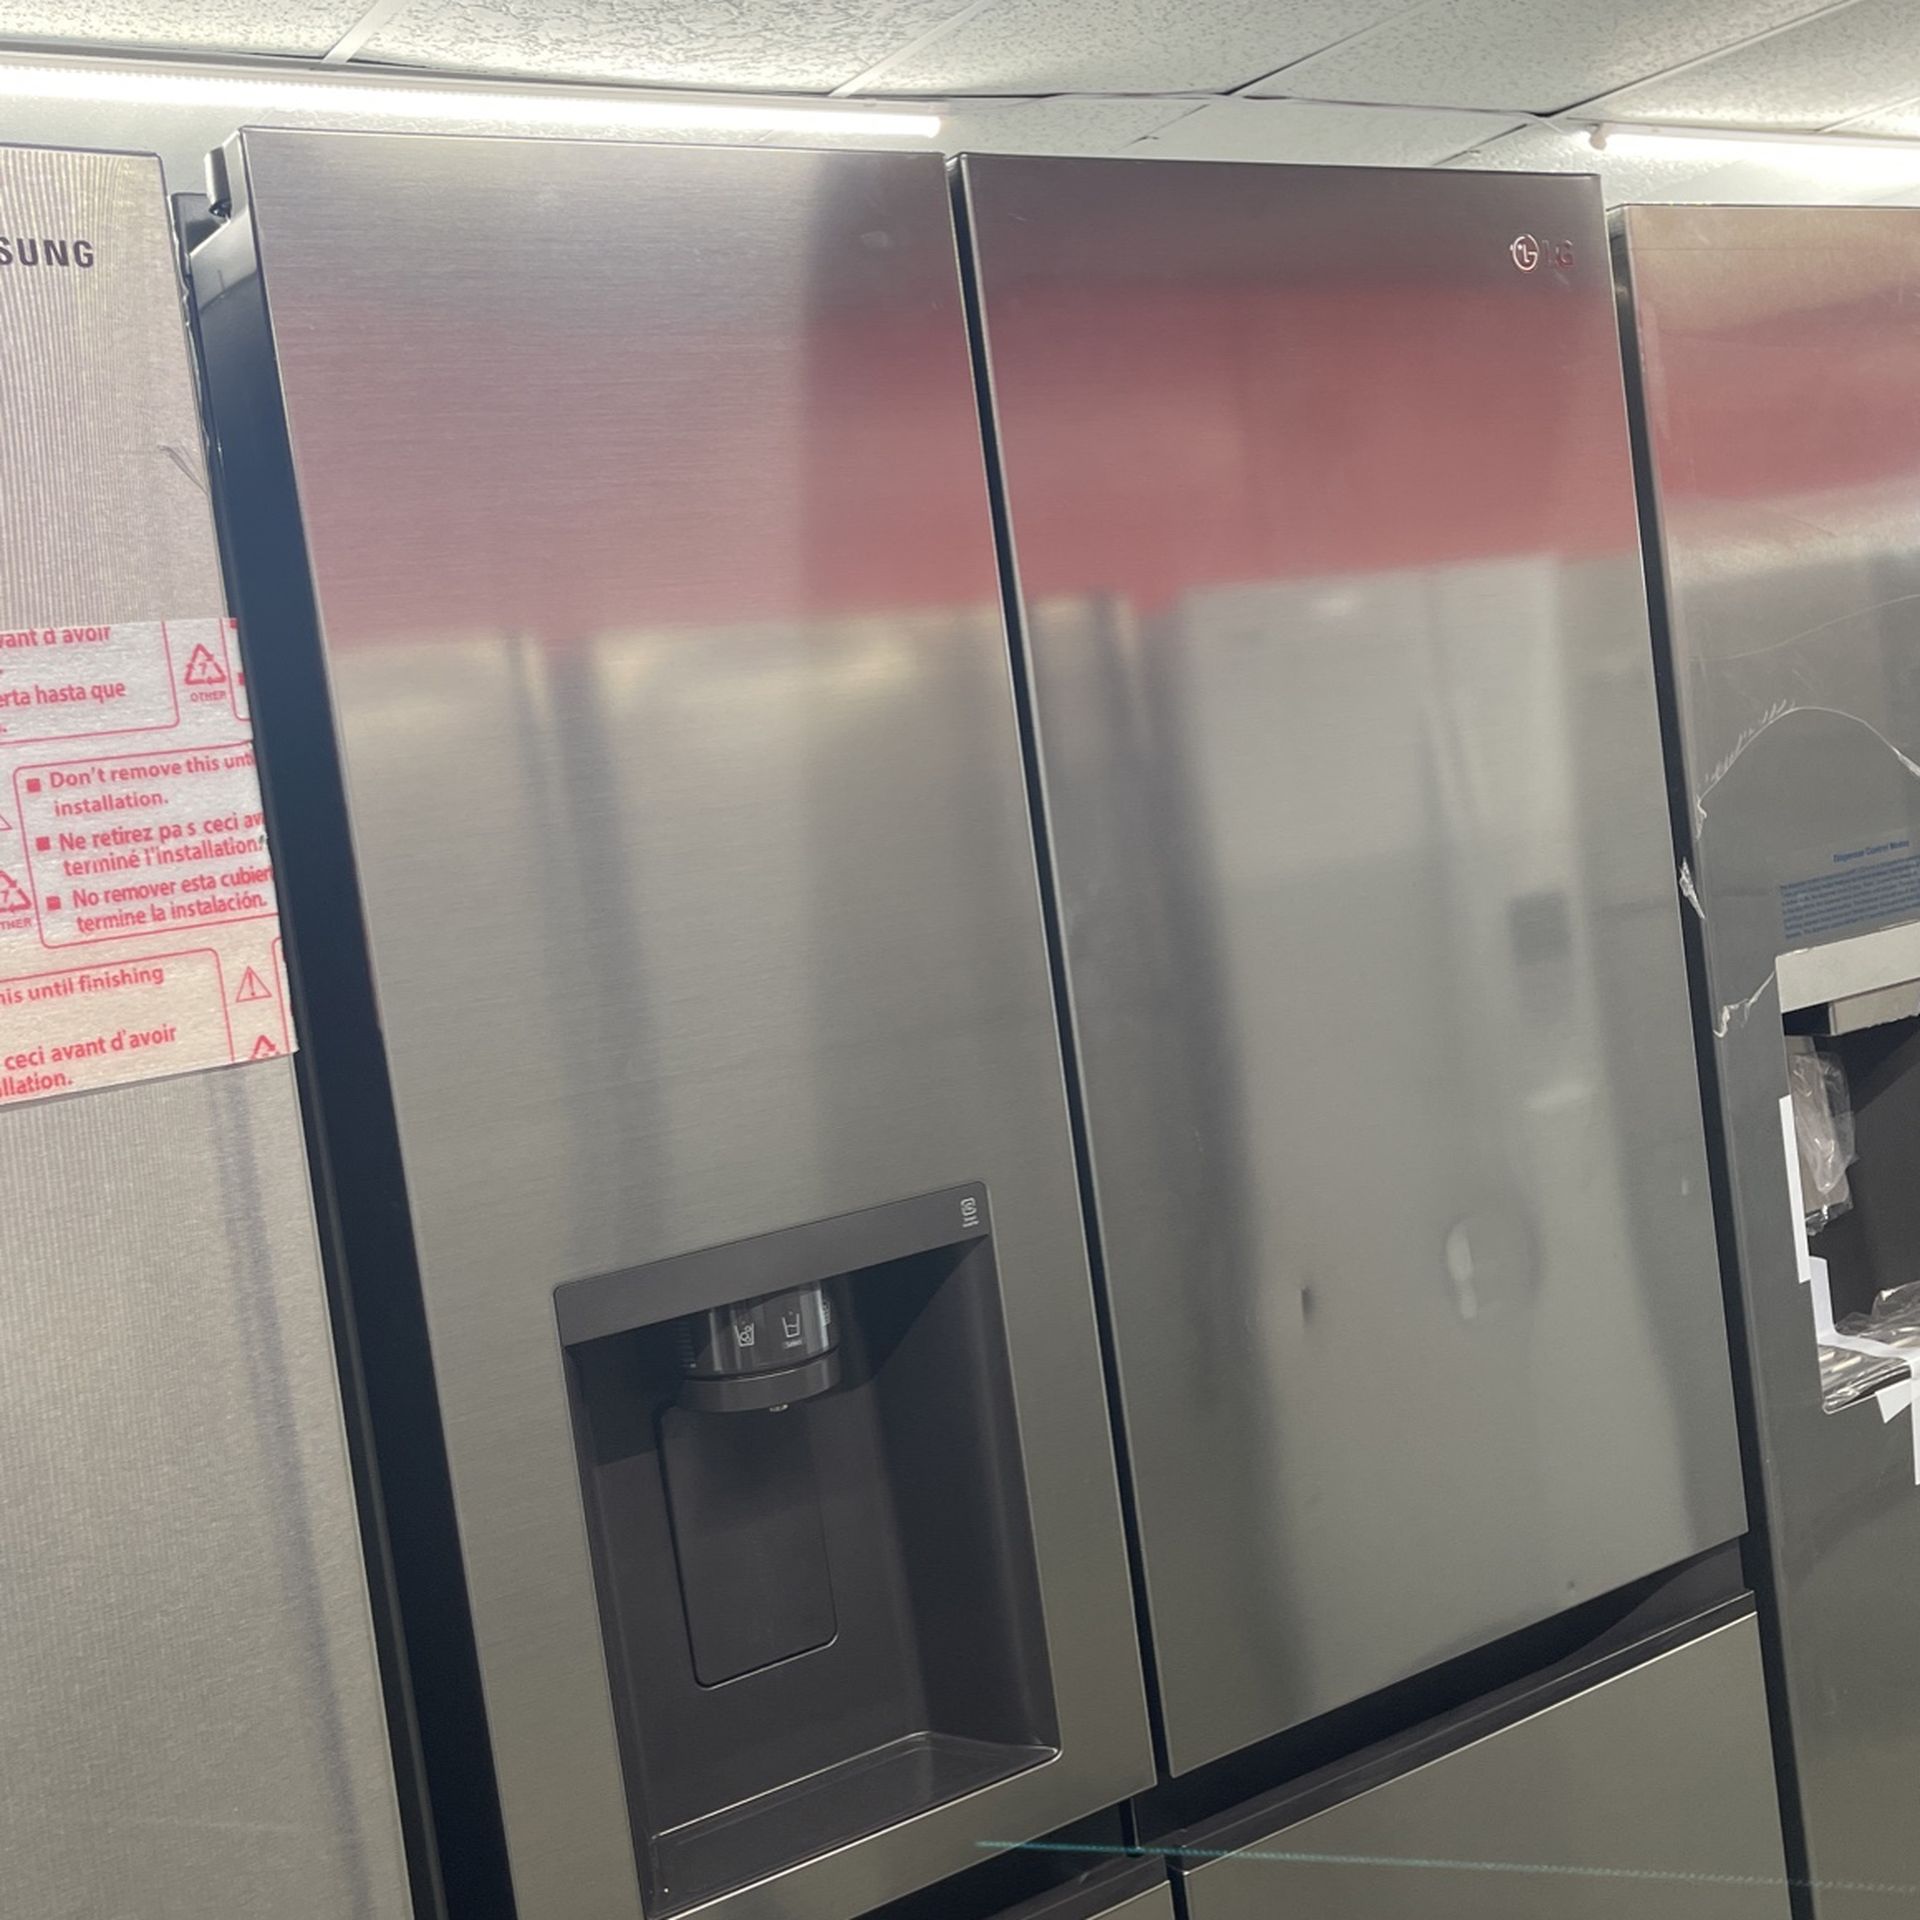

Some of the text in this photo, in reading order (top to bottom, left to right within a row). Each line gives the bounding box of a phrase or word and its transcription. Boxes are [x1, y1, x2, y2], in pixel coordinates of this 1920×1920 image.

[35, 684, 86, 704] hasta
[91, 683, 126, 703] que
[191, 690, 226, 702] OTHER
[51, 767, 106, 788] Don't
[111, 762, 182, 782] remove
[187, 755, 220, 774] this
[55, 791, 168, 817] installation.
[59, 832, 87, 851] Ne
[92, 825, 153, 848] retirez
[203, 811, 239, 834] ceci
[64, 850, 140, 877] terminé
[72, 888, 100, 909] No
[104, 881, 176, 903] remover
[181, 872, 217, 894] esta
[77, 891, 268, 933] termine la instalación.
[28, 977, 74, 1001] until
[79, 967, 165, 993] finishing
[4, 1024, 178, 1070] ceci avant d'avoir
[0, 1072, 73, 1098] llation.
